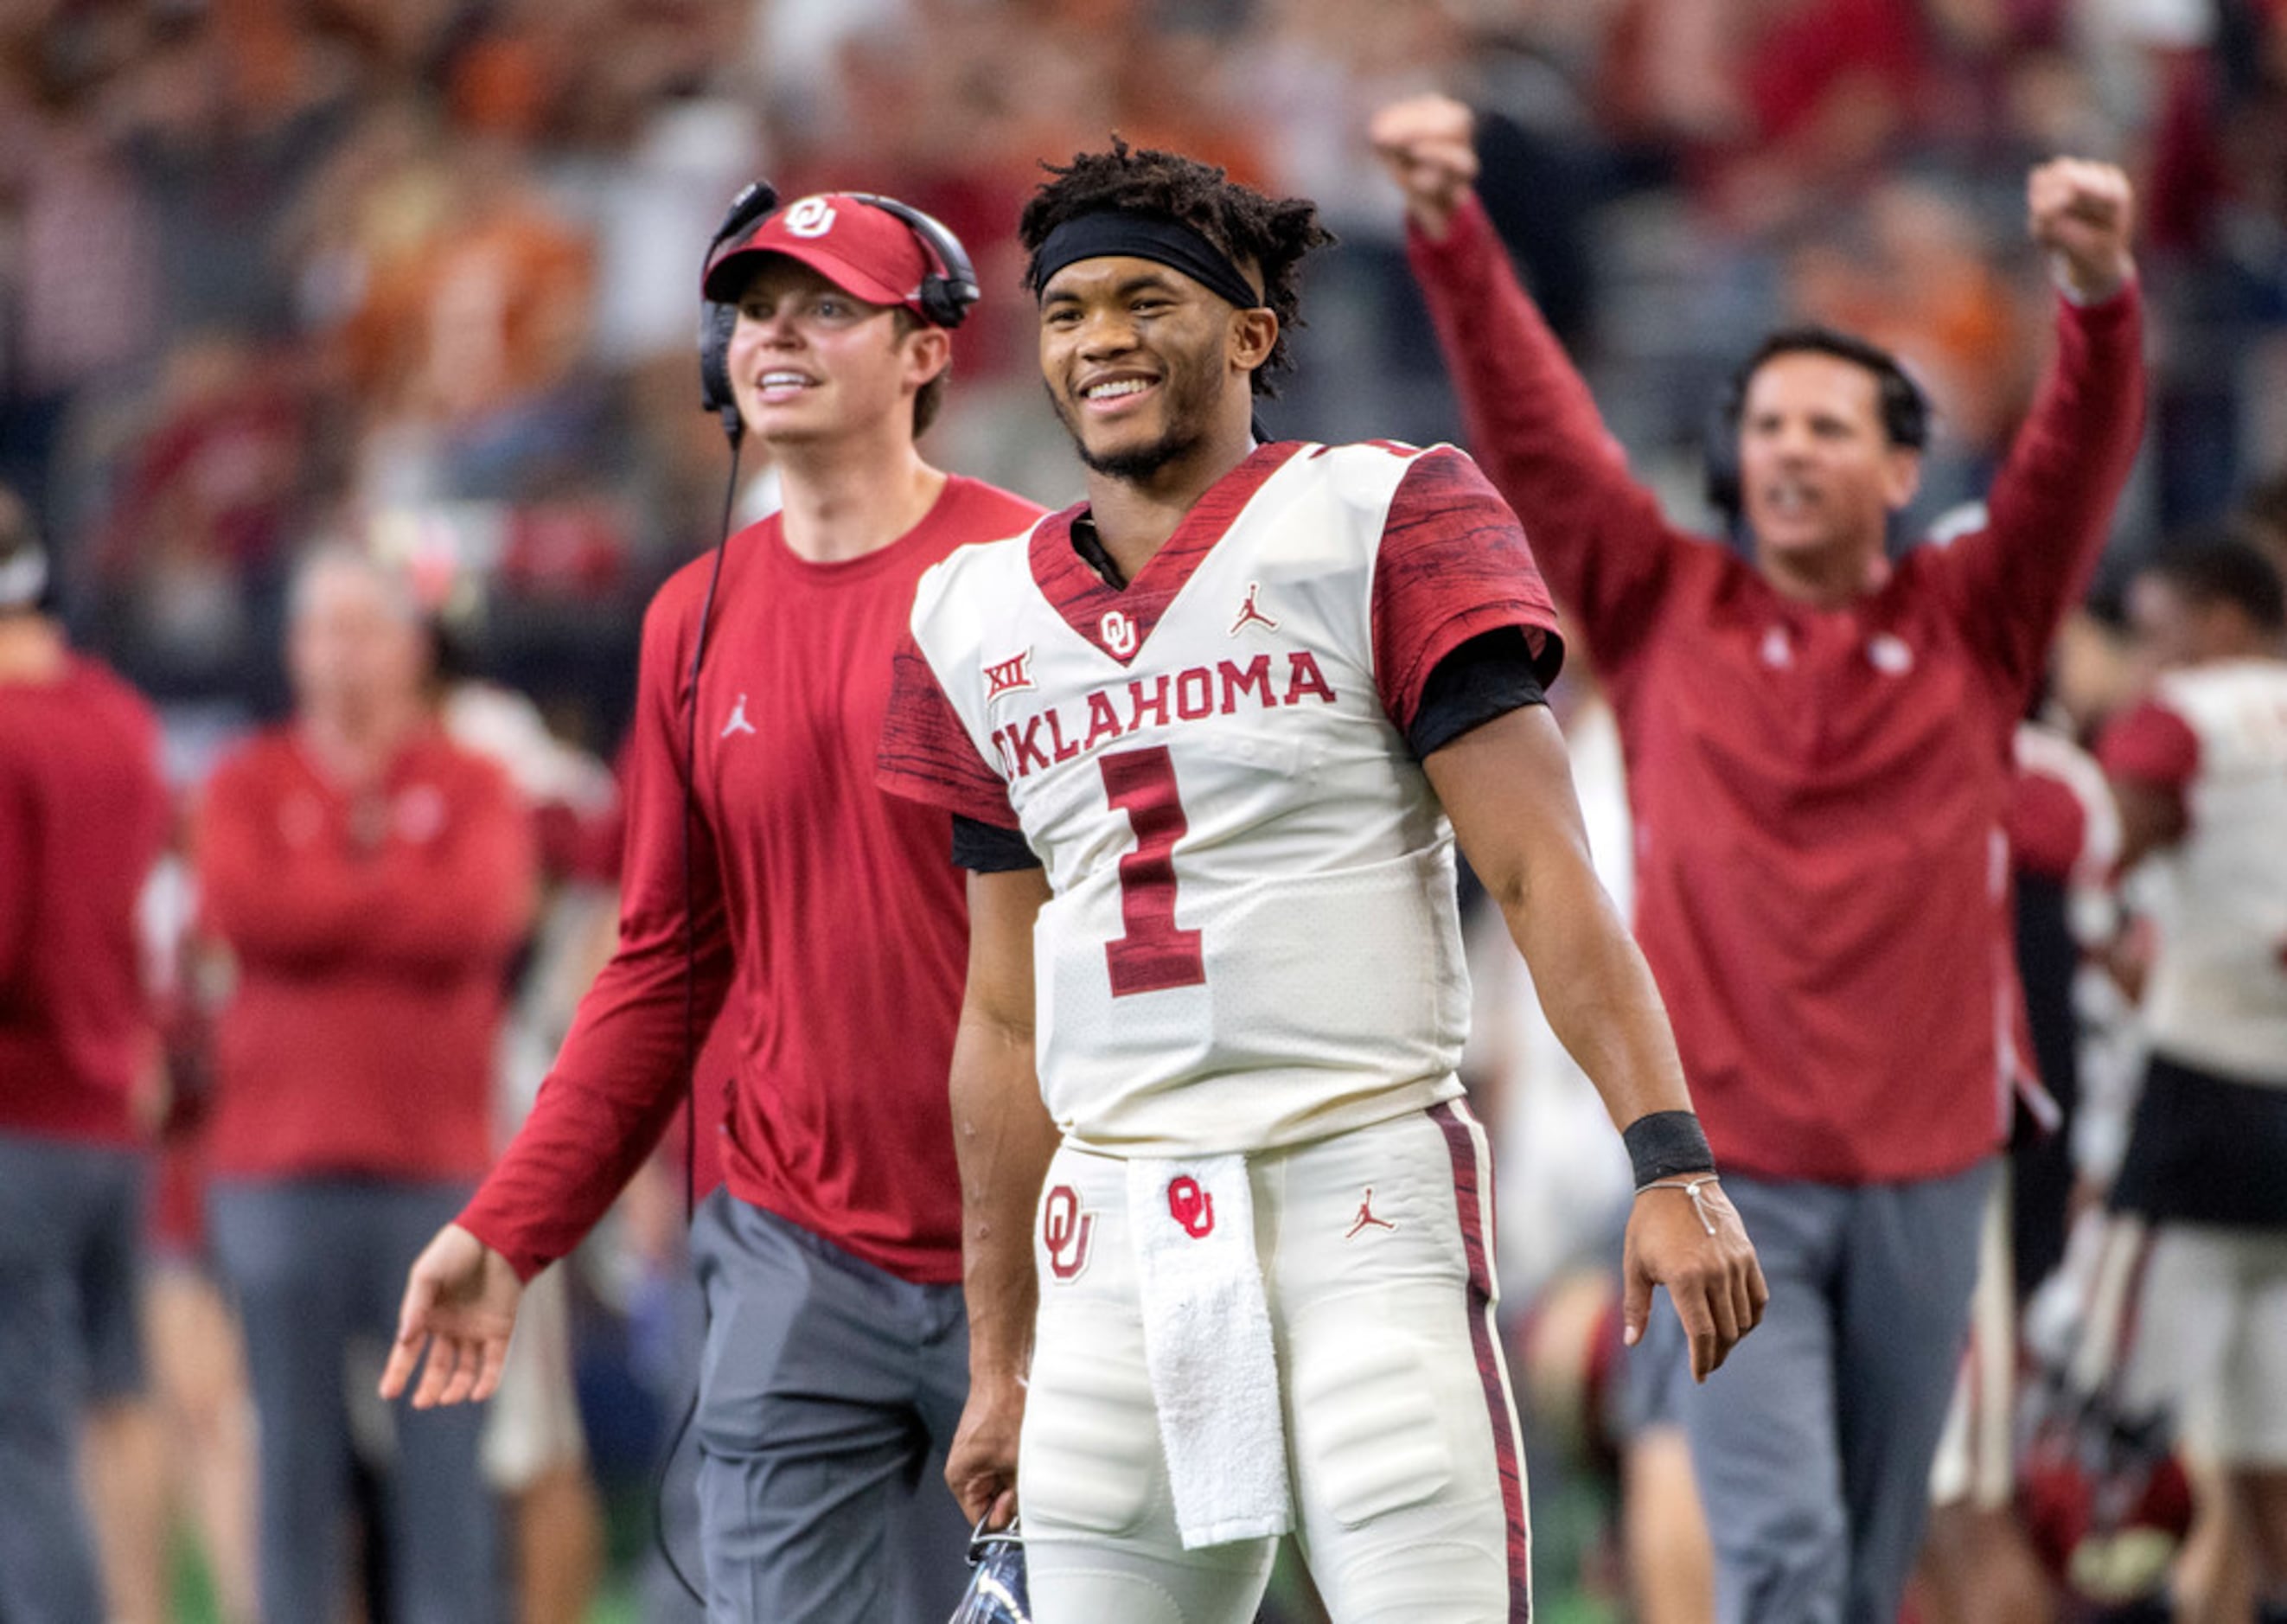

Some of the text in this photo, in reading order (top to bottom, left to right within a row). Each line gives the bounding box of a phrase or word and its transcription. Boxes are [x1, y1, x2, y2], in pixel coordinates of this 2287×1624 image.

[784, 196, 837, 238] OU
[1100, 611, 1135, 655] OU
[1098, 745, 1205, 998] 1
[1044, 1185, 1091, 1278] OU
[1168, 1174, 1215, 1239] OU
